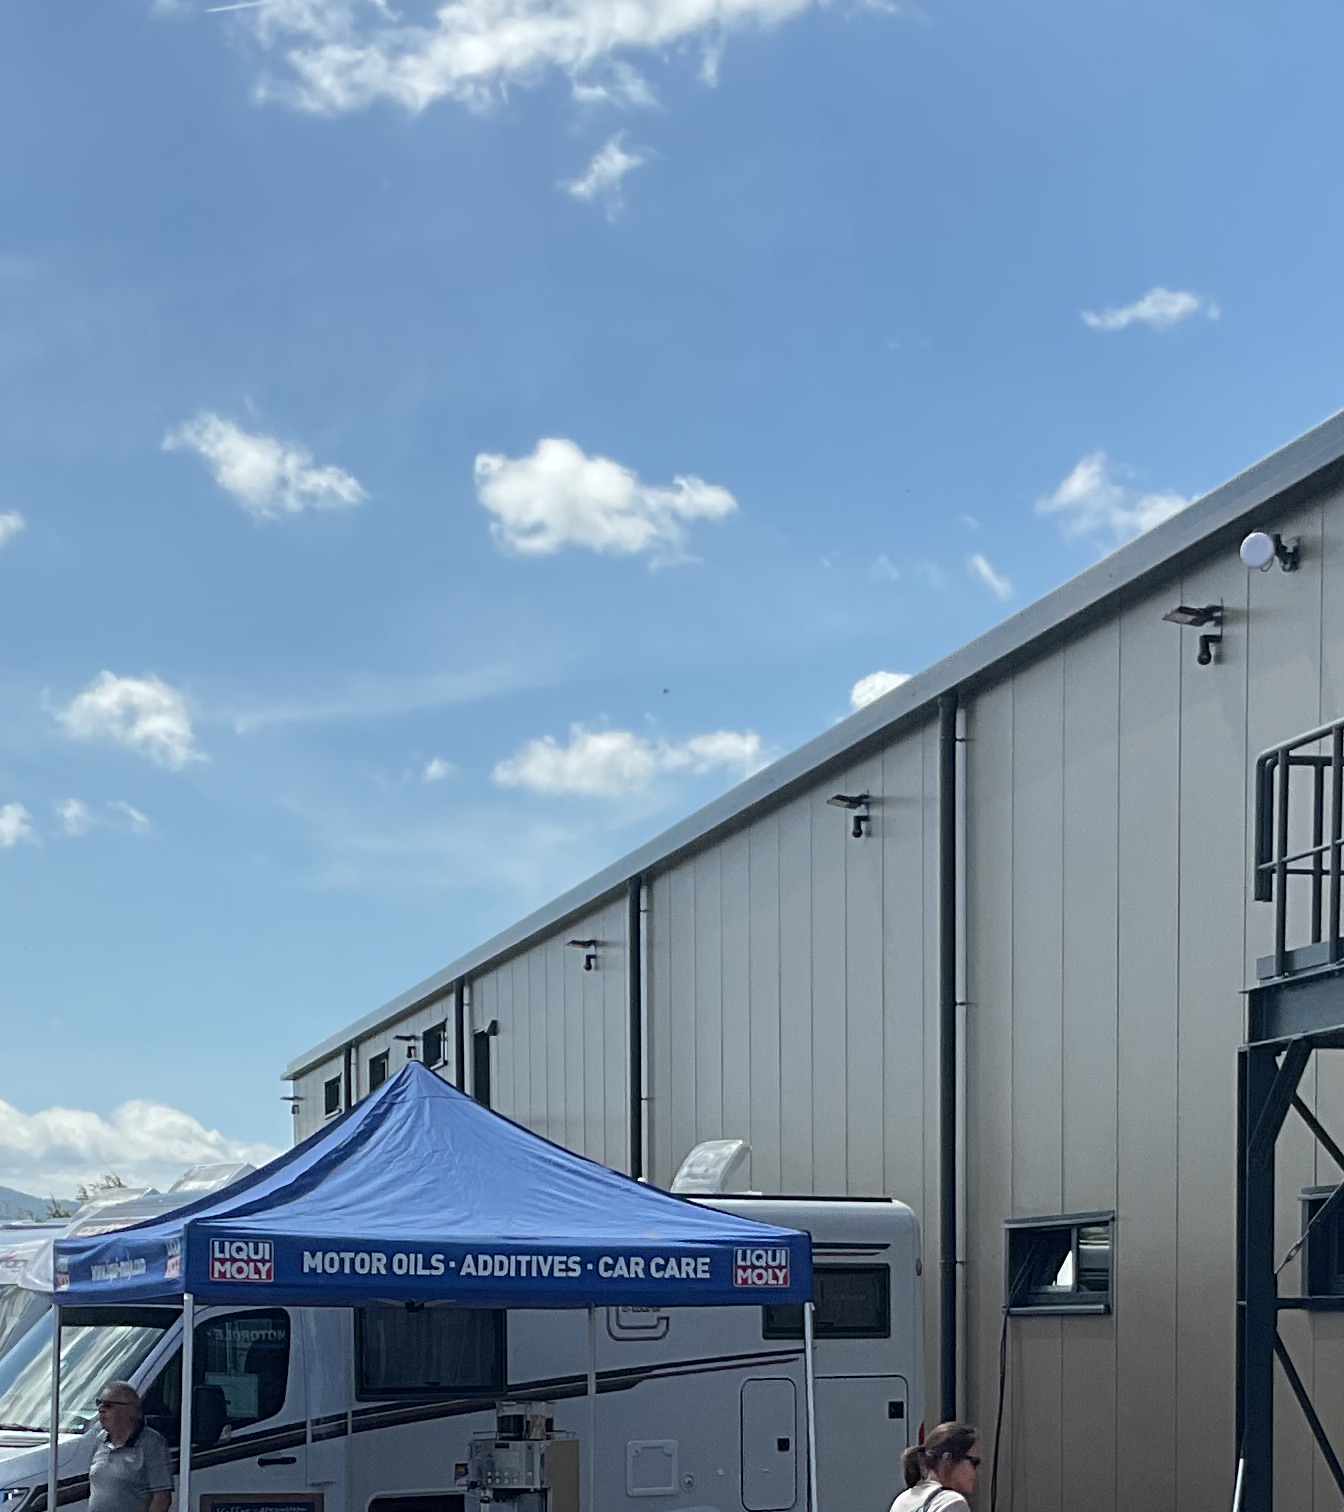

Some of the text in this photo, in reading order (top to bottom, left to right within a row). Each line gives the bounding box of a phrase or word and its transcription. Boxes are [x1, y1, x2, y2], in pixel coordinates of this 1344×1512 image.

[213, 1241, 270, 1260] LIQUI
[736, 1249, 787, 1267] LIQUI
[213, 1261, 272, 1280] MOLY
[302, 1251, 711, 1279] MOTOR OILS ADDITIVES CAR CARE
[736, 1268, 787, 1285] MOLY
